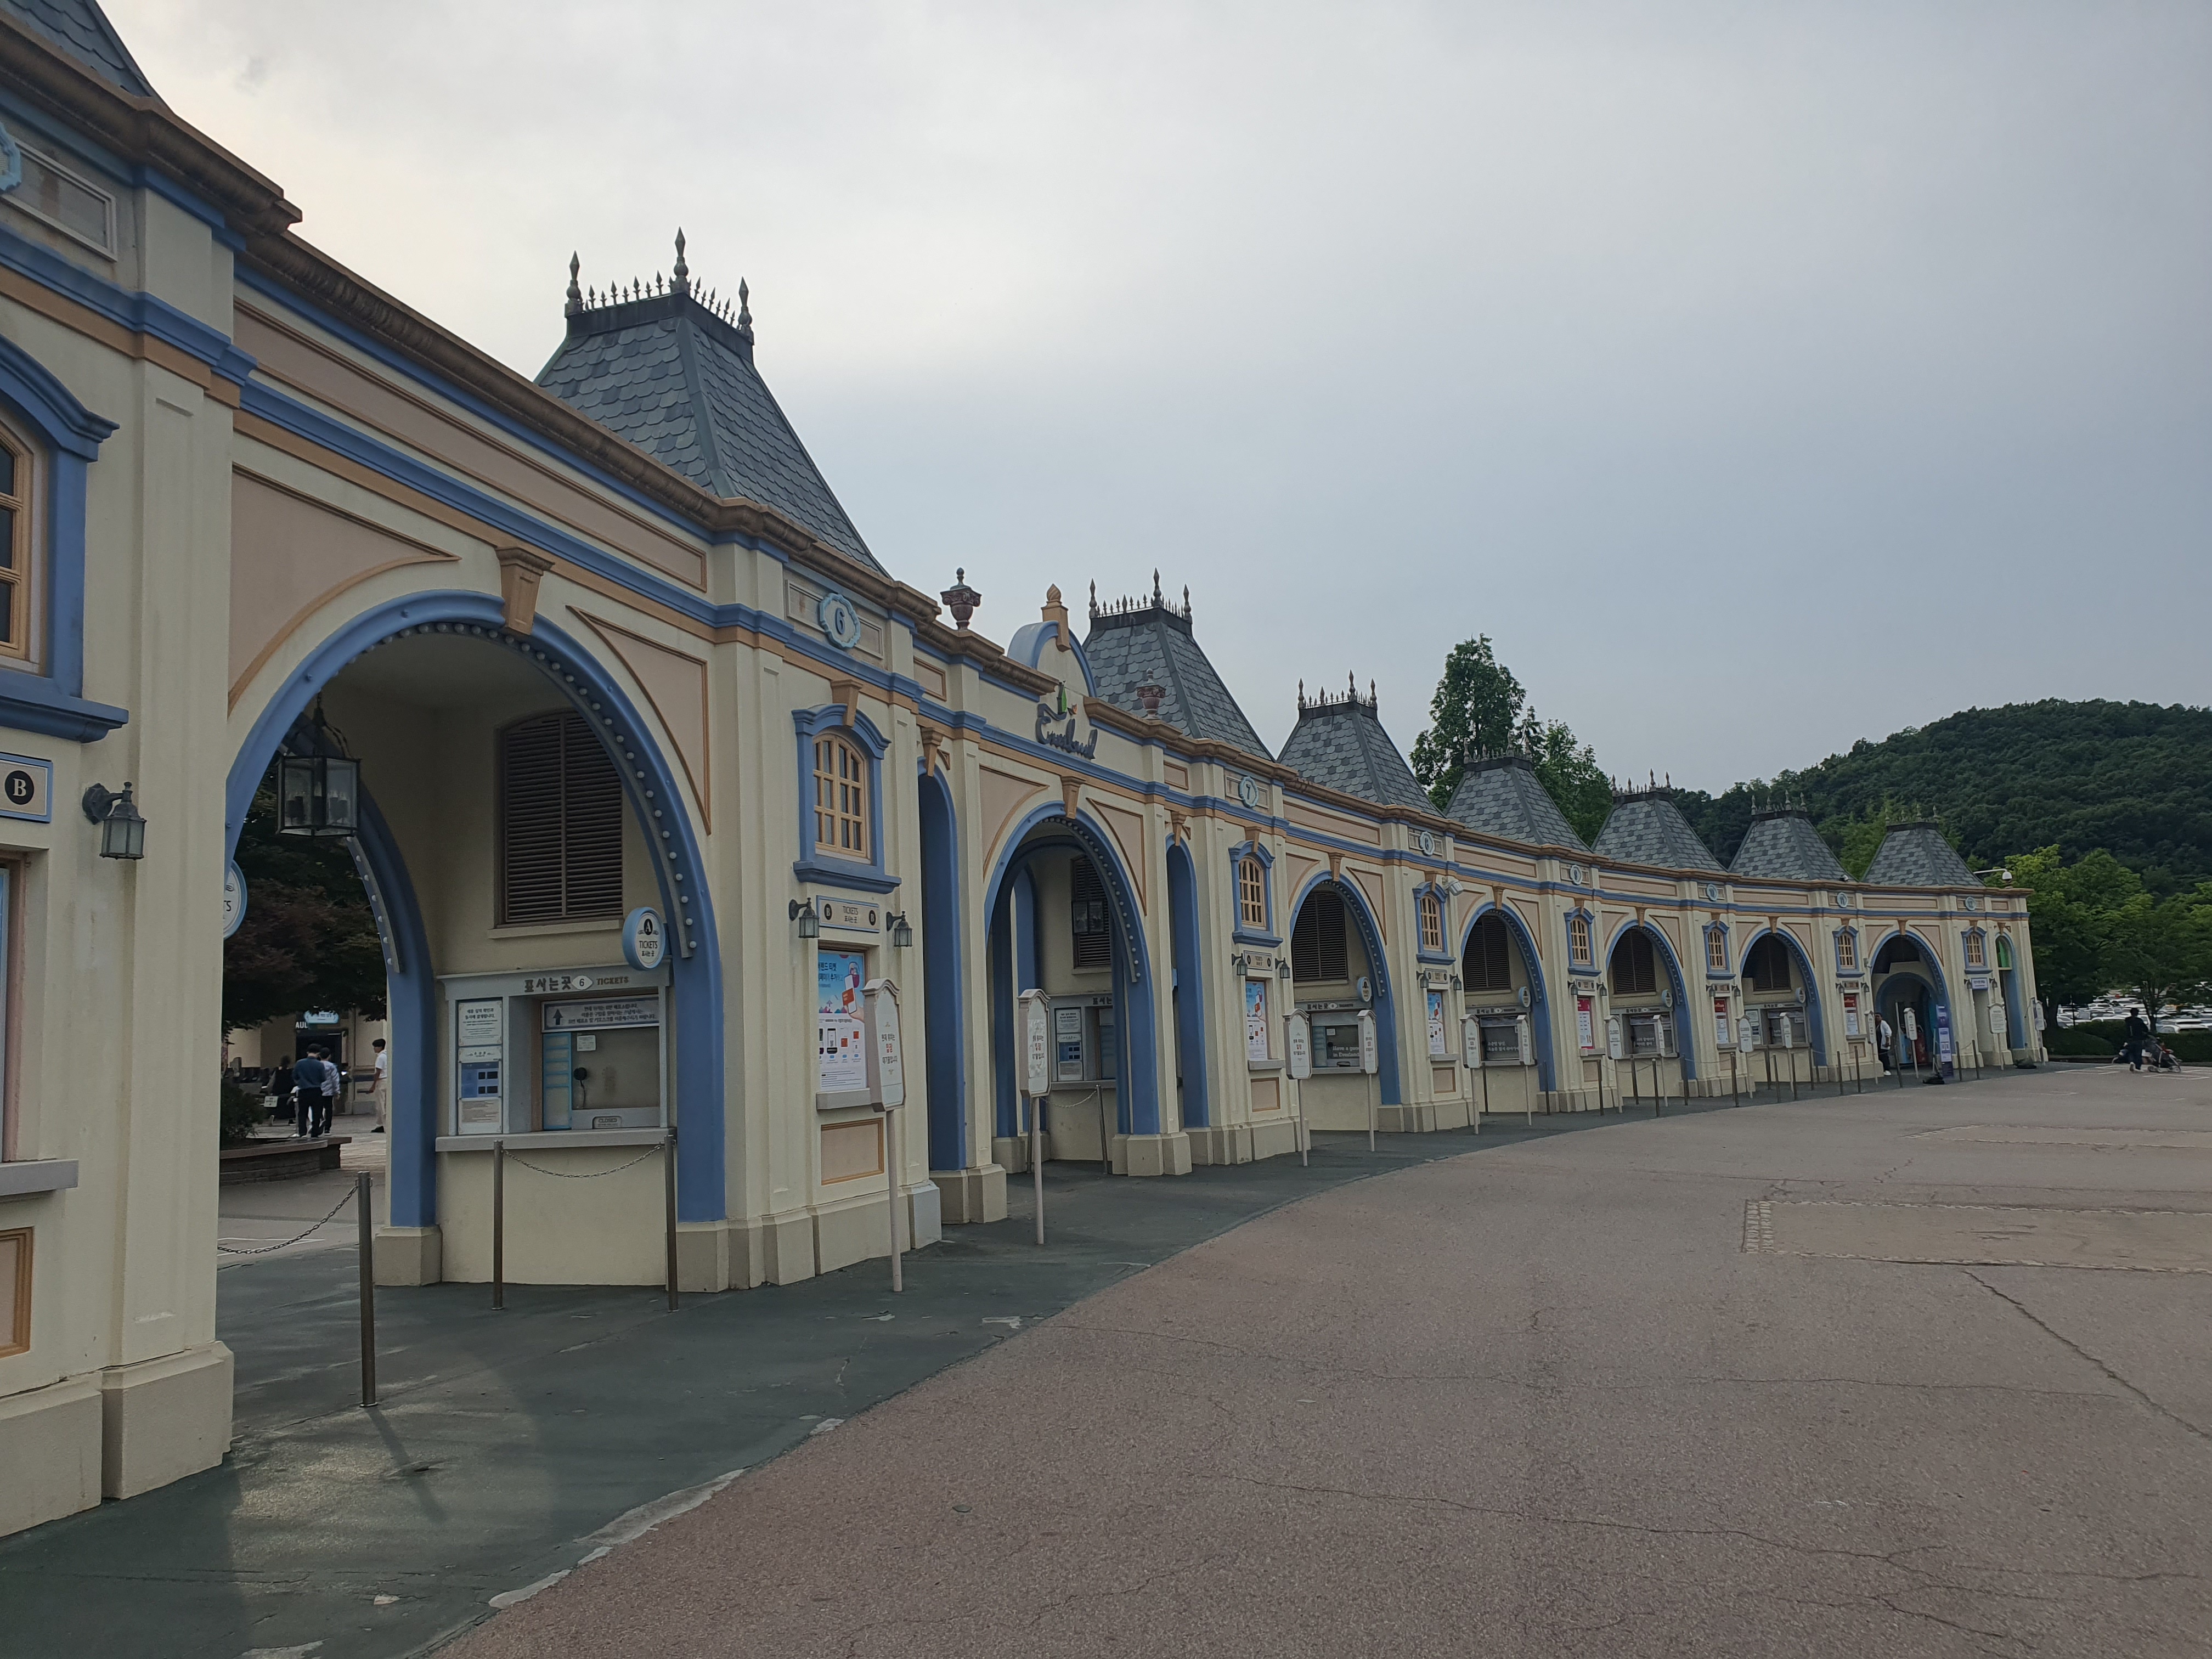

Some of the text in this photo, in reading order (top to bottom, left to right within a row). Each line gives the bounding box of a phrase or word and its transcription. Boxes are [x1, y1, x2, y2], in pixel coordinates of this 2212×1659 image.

[835, 607, 845, 635] 6
[13, 778, 27, 797] B
[1246, 783, 1251, 800] 7
[639, 940, 658, 949] TICKETS
[524, 976, 571, 992] 표사는곳
[596, 977, 629, 985] TICKETS
[1092, 997, 1112, 1005] 표사는
